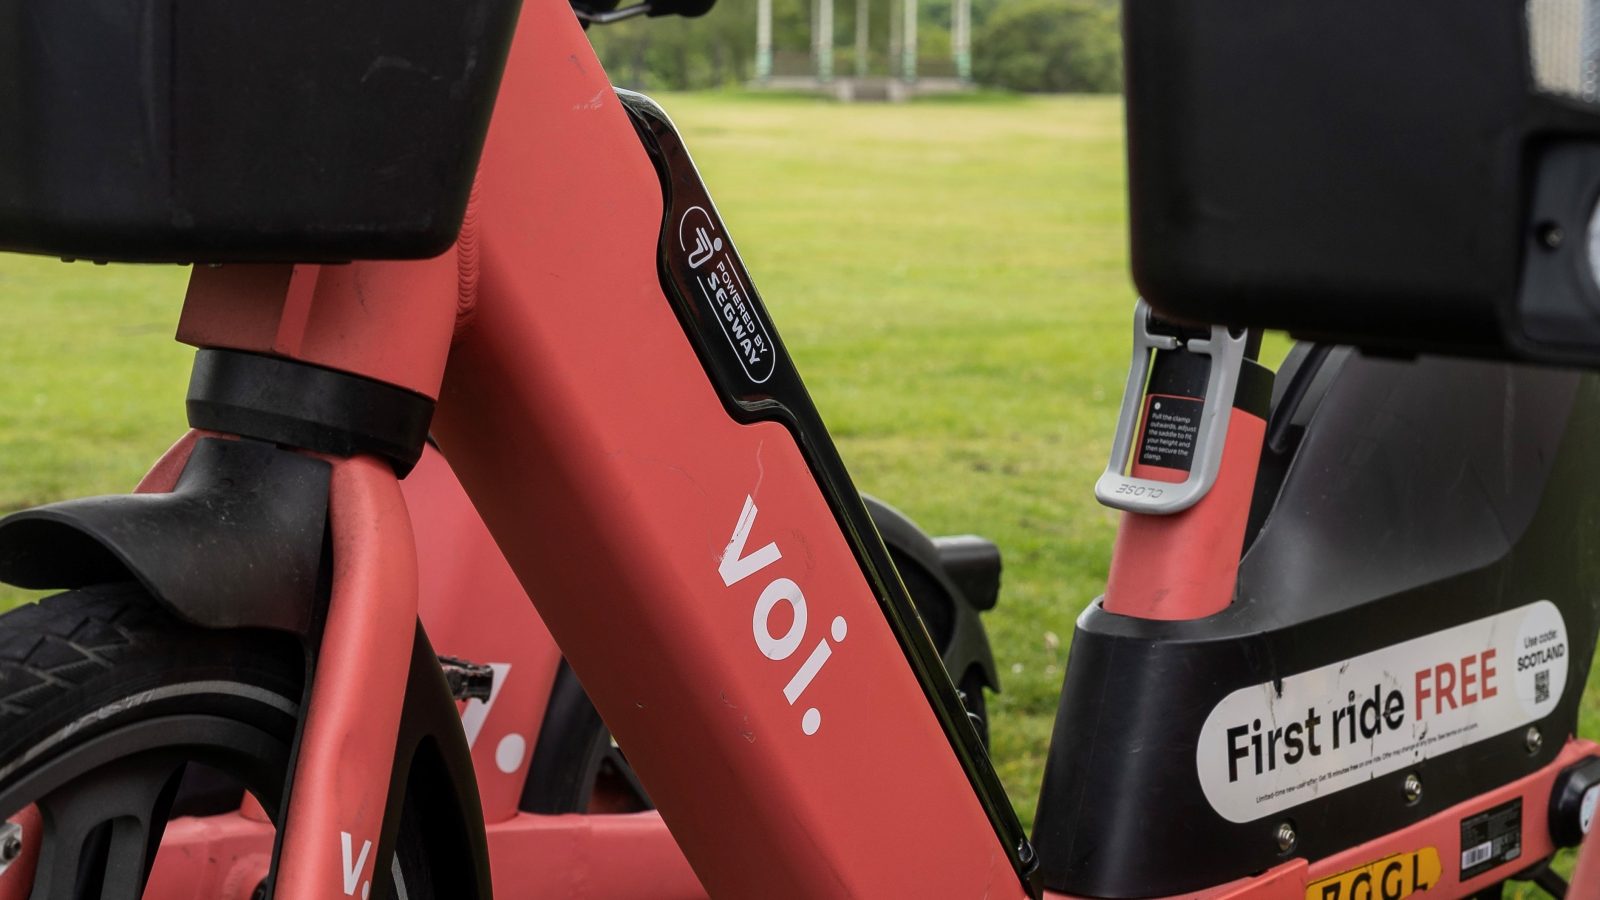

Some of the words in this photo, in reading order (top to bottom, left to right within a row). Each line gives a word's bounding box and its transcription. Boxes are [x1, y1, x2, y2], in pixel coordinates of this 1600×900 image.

[707, 272, 760, 365] SEGWAY
[717, 261, 755, 334] POWERED
[754, 334, 767, 353] BY
[1172, 415, 1191, 423] clamp
[1178, 424, 1197, 432] adjust
[1116, 484, 1163, 499] CLOSE
[718, 494, 847, 736] voi.
[1524, 635, 1538, 649] Use
[1517, 643, 1565, 672] SCOTLAND
[1227, 708, 1321, 783] First
[1332, 684, 1405, 750] ride
[1415, 648, 1498, 721] FREE
